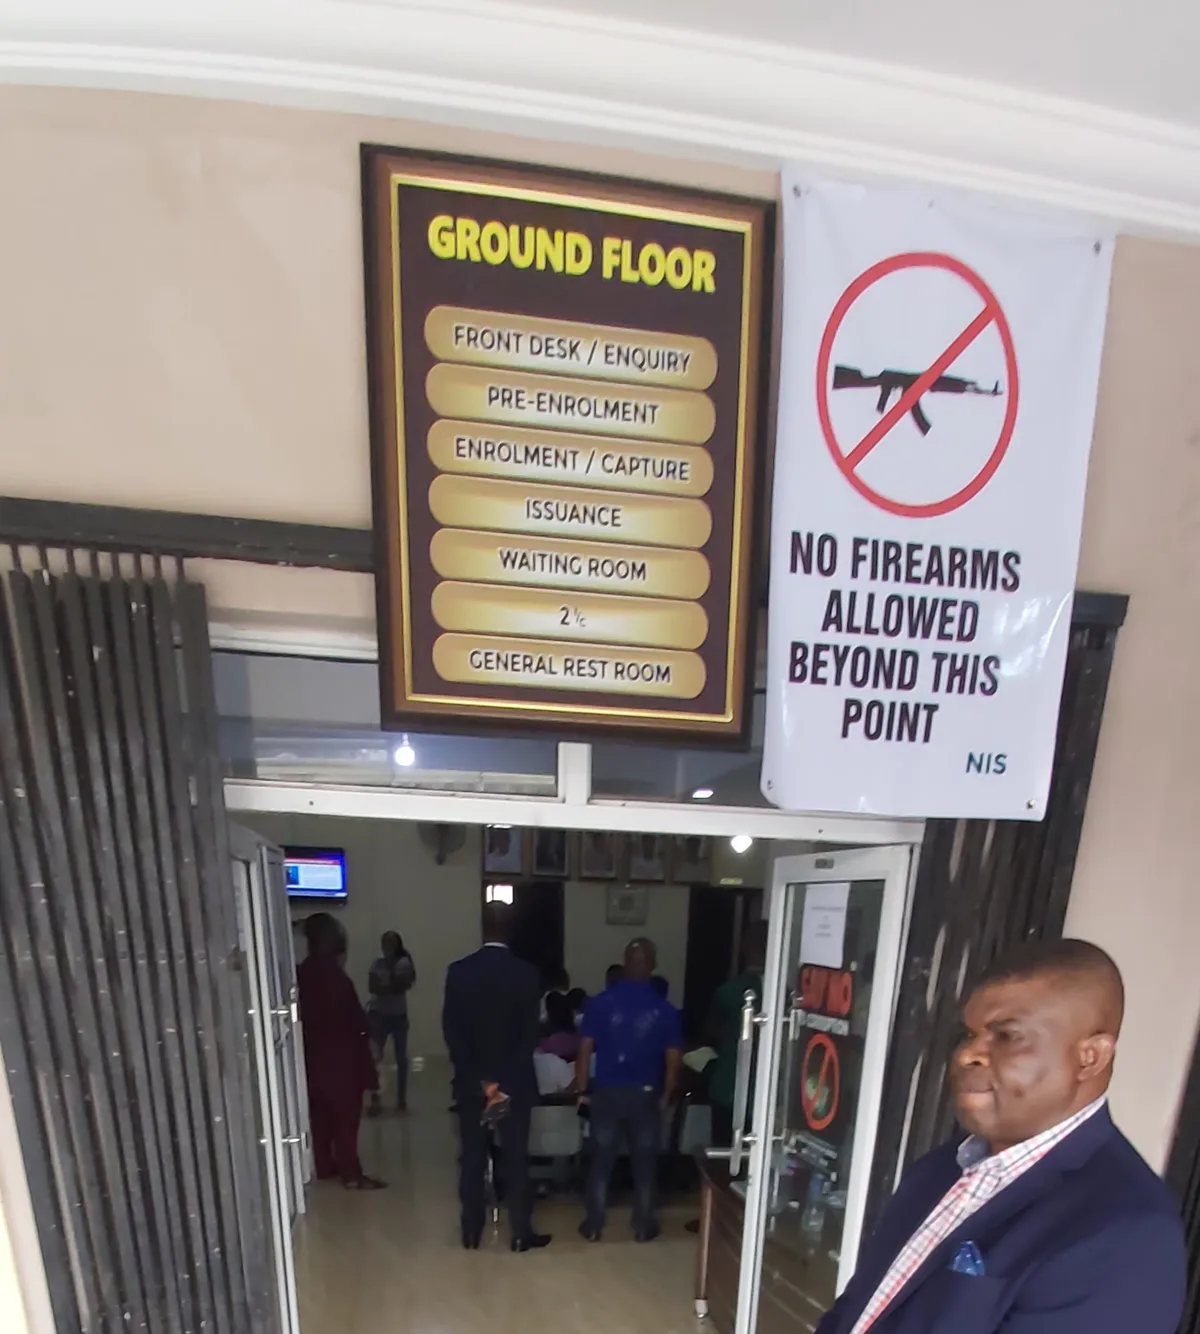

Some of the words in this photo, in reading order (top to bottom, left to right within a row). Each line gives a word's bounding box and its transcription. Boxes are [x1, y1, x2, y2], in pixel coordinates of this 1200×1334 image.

[428, 215, 593, 275] GROUND
[602, 237, 717, 293] FLOOR
[454, 325, 523, 354] FRONT
[529, 336, 581, 362] DESK
[586, 339, 599, 365] /
[604, 344, 691, 374] ENQUIRY
[488, 386, 660, 424] PRE-ENROLMENT
[455, 437, 581, 472] ENROLMENT
[584, 449, 597, 474] /
[601, 453, 691, 481] CAPTURE
[525, 498, 623, 527] ISSUANCE
[499, 547, 583, 576] WAITING
[588, 557, 647, 580] ROOM
[790, 530, 838, 577] NO
[850, 537, 1021, 592] FIREARMS
[560, 606, 570, 626] 2
[821, 589, 979, 642] ALLOWED
[469, 650, 558, 675] GENERAL
[563, 659, 607, 679] REST
[614, 663, 671, 683] ROOM
[789, 641, 919, 691] BEYOND
[931, 652, 1000, 696] THIS
[841, 698, 939, 743] POINT
[966, 752, 1007, 775] NIS
